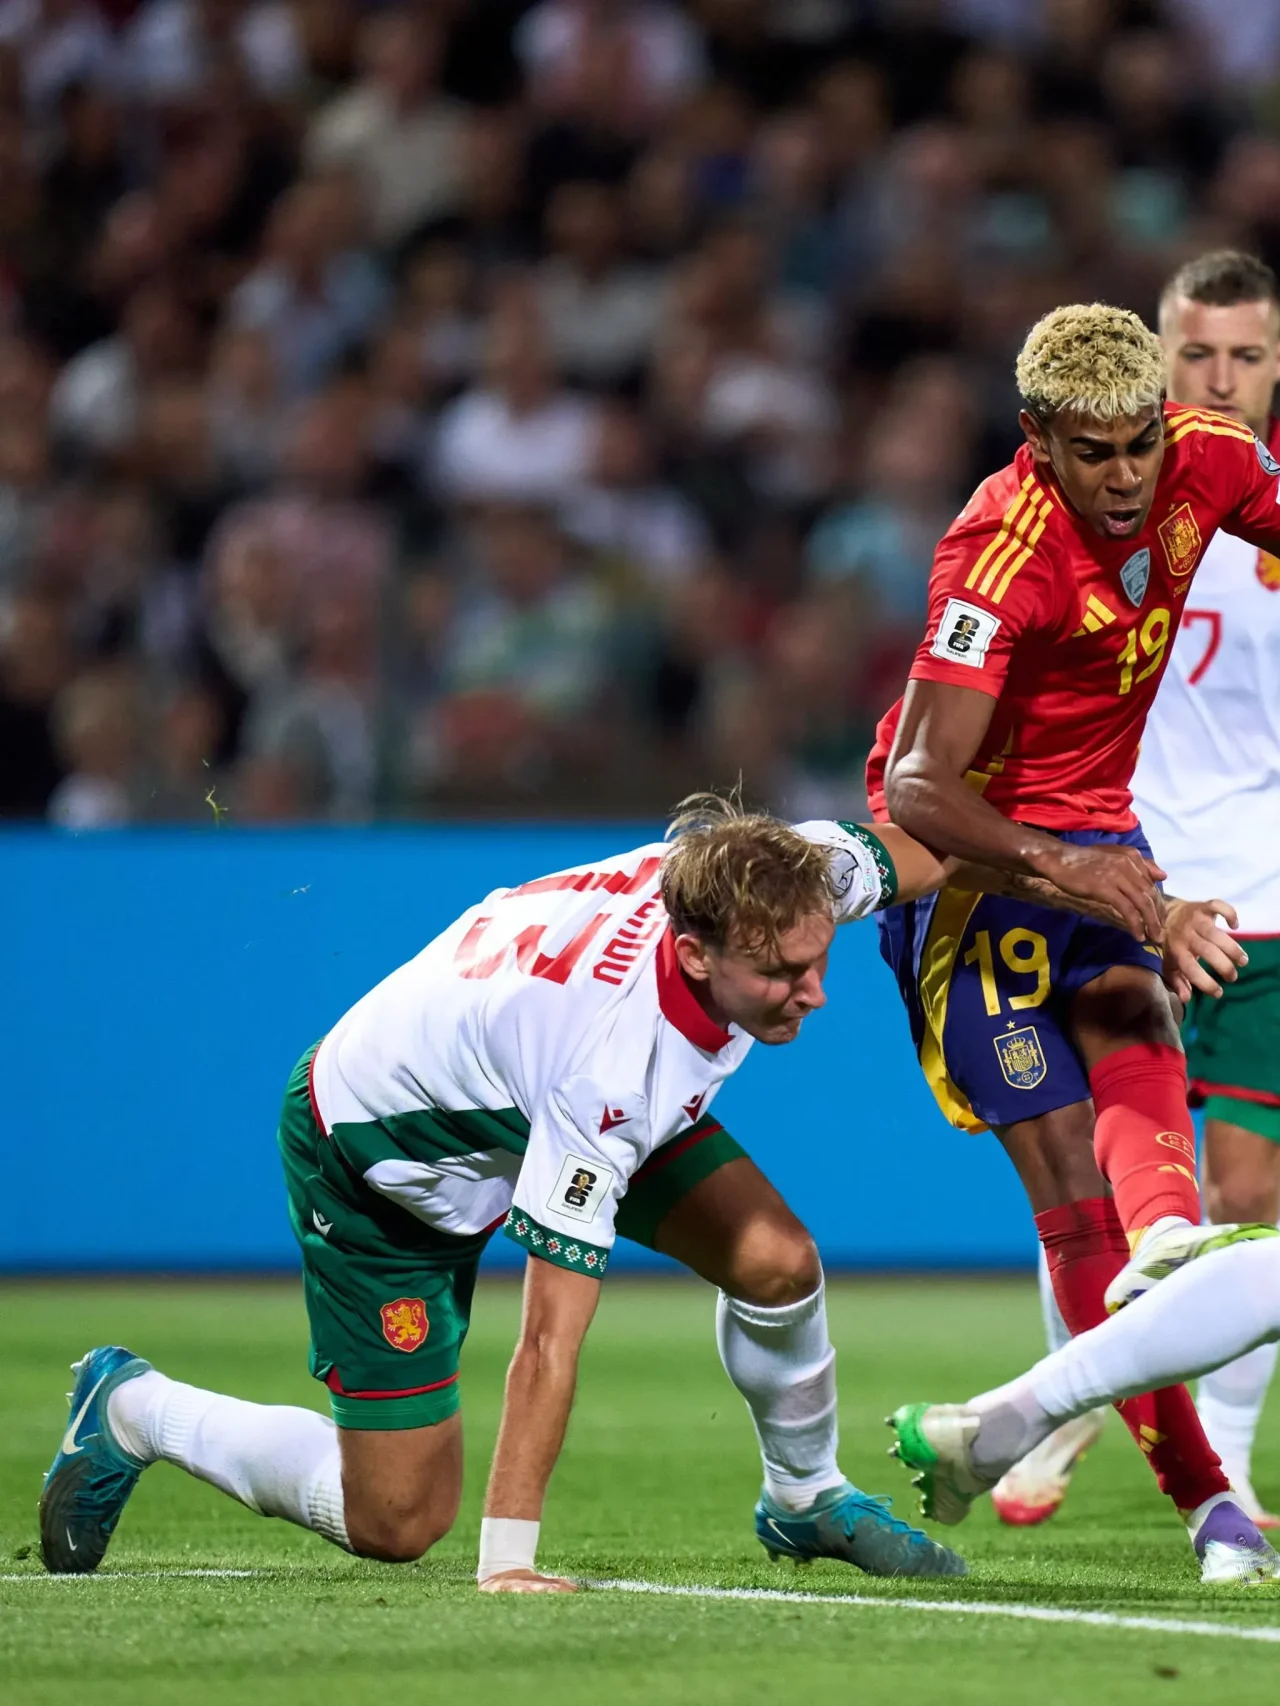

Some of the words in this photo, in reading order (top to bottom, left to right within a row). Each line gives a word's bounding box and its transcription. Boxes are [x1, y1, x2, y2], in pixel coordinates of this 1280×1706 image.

[1116, 608, 1170, 695] 19
[1182, 609, 1223, 687] 7
[964, 927, 1051, 1016] 19
